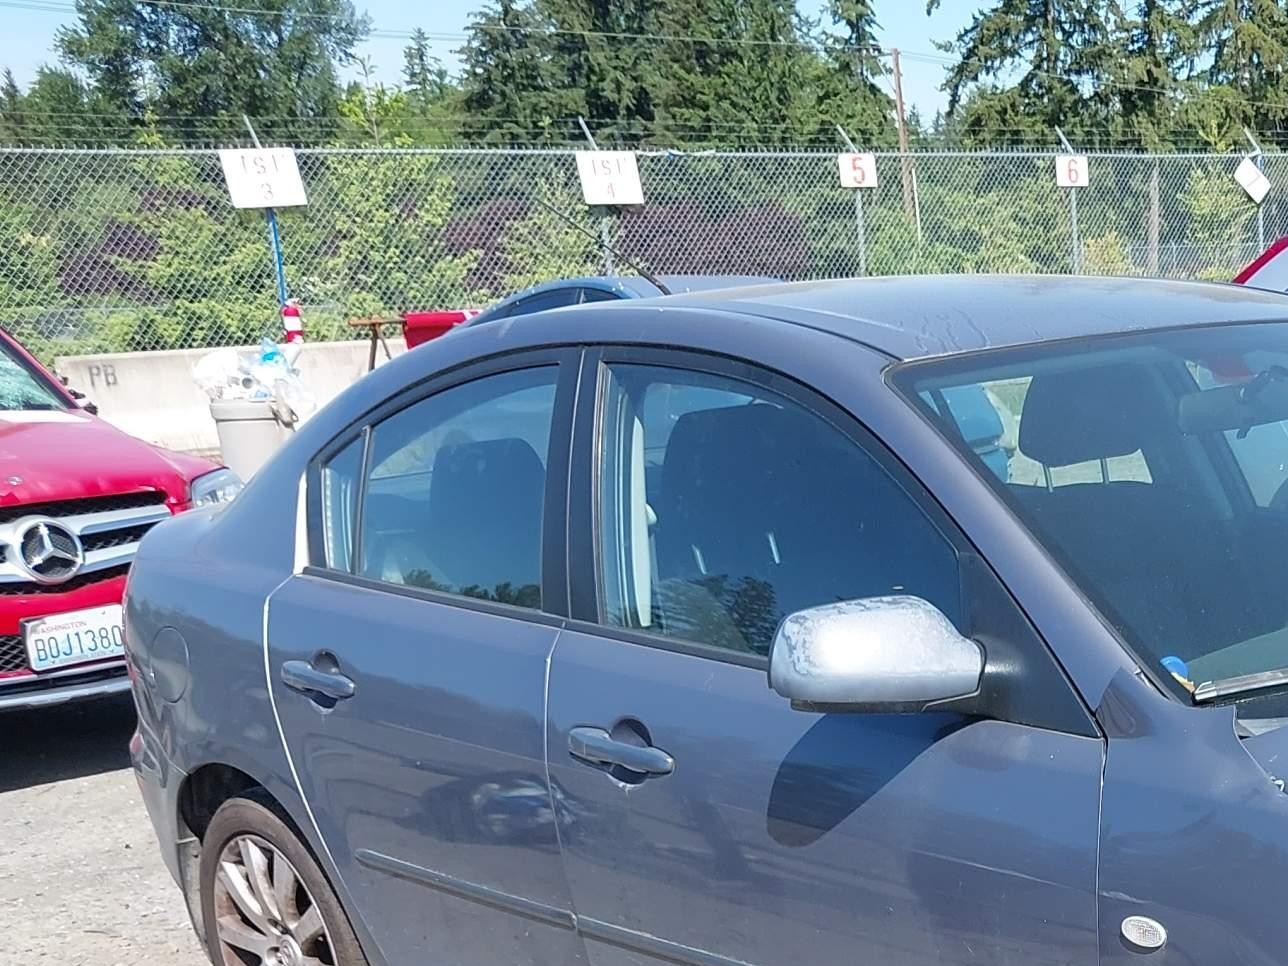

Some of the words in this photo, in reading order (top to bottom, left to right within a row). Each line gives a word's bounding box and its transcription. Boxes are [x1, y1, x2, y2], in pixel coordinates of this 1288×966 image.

[852, 156, 865, 185] 5
[1067, 158, 1079, 184] 6
[88, 364, 118, 389] PB
